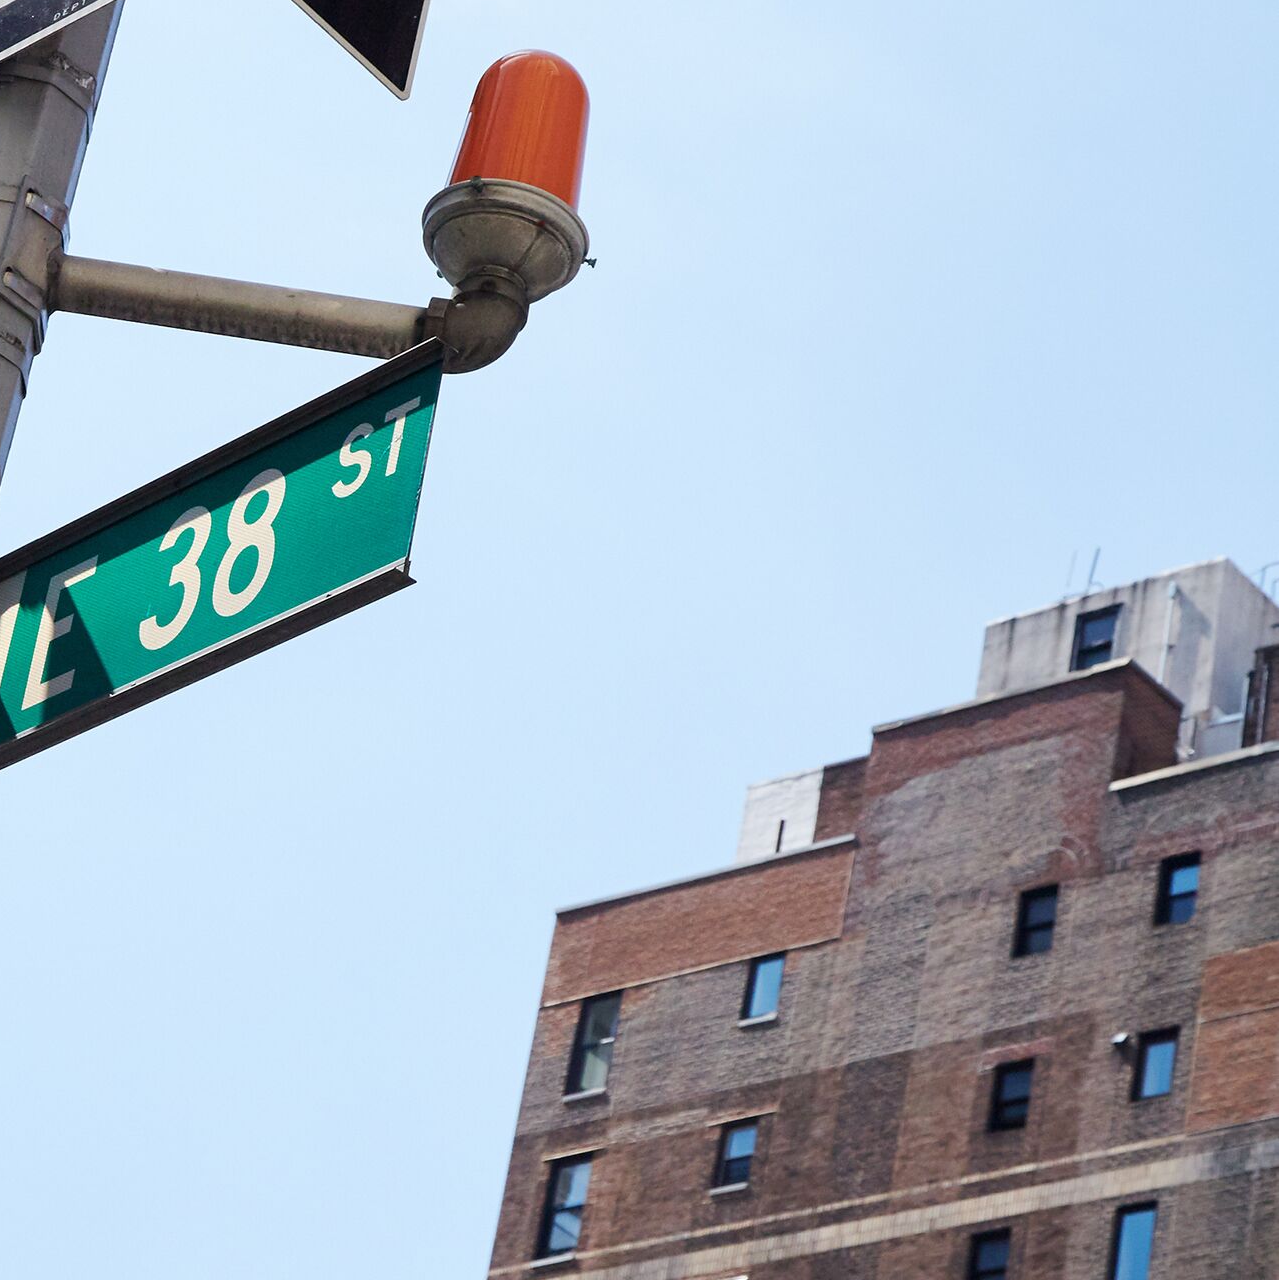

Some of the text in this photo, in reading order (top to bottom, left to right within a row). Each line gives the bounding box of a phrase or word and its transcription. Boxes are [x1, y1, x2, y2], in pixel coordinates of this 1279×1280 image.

[20, 396, 422, 712] E 38 ST
